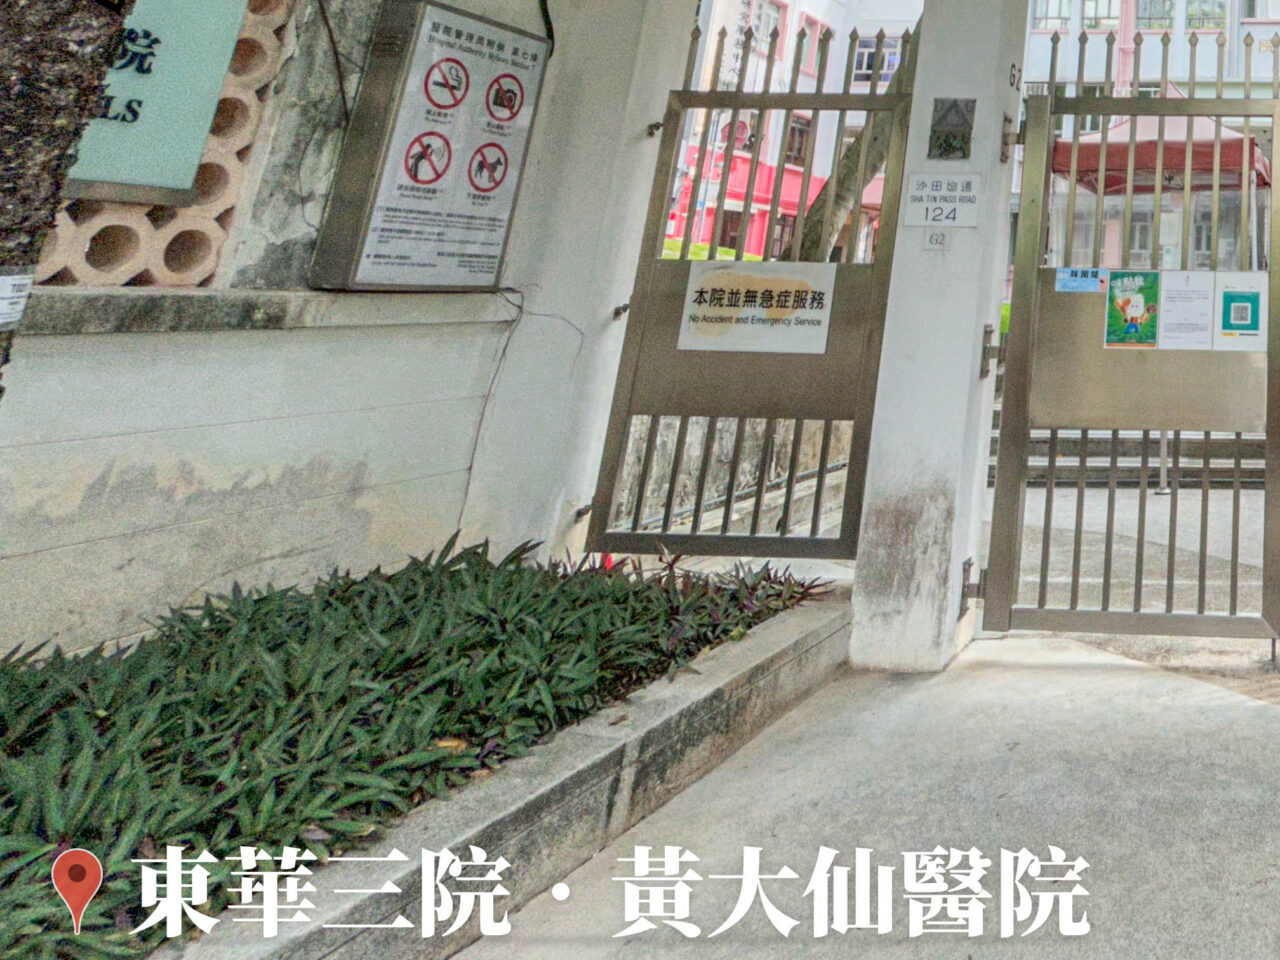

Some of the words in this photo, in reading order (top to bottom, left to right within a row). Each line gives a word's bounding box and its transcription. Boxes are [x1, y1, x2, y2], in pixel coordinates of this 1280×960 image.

[915, 180, 973, 193] 沙田坳道
[910, 195, 924, 203] SHA
[926, 195, 937, 203] TIN
[939, 195, 957, 203] PASS
[958, 195, 976, 204] ROAD
[925, 206, 958, 222] 124
[929, 232, 945, 246] G2
[692, 287, 825, 310] 本院並無急症服務
[689, 314, 699, 323] No
[701, 314, 733, 324] Accident
[734, 316, 749, 325] and
[751, 315, 793, 327] Emergency
[794, 316, 822, 326] Service
